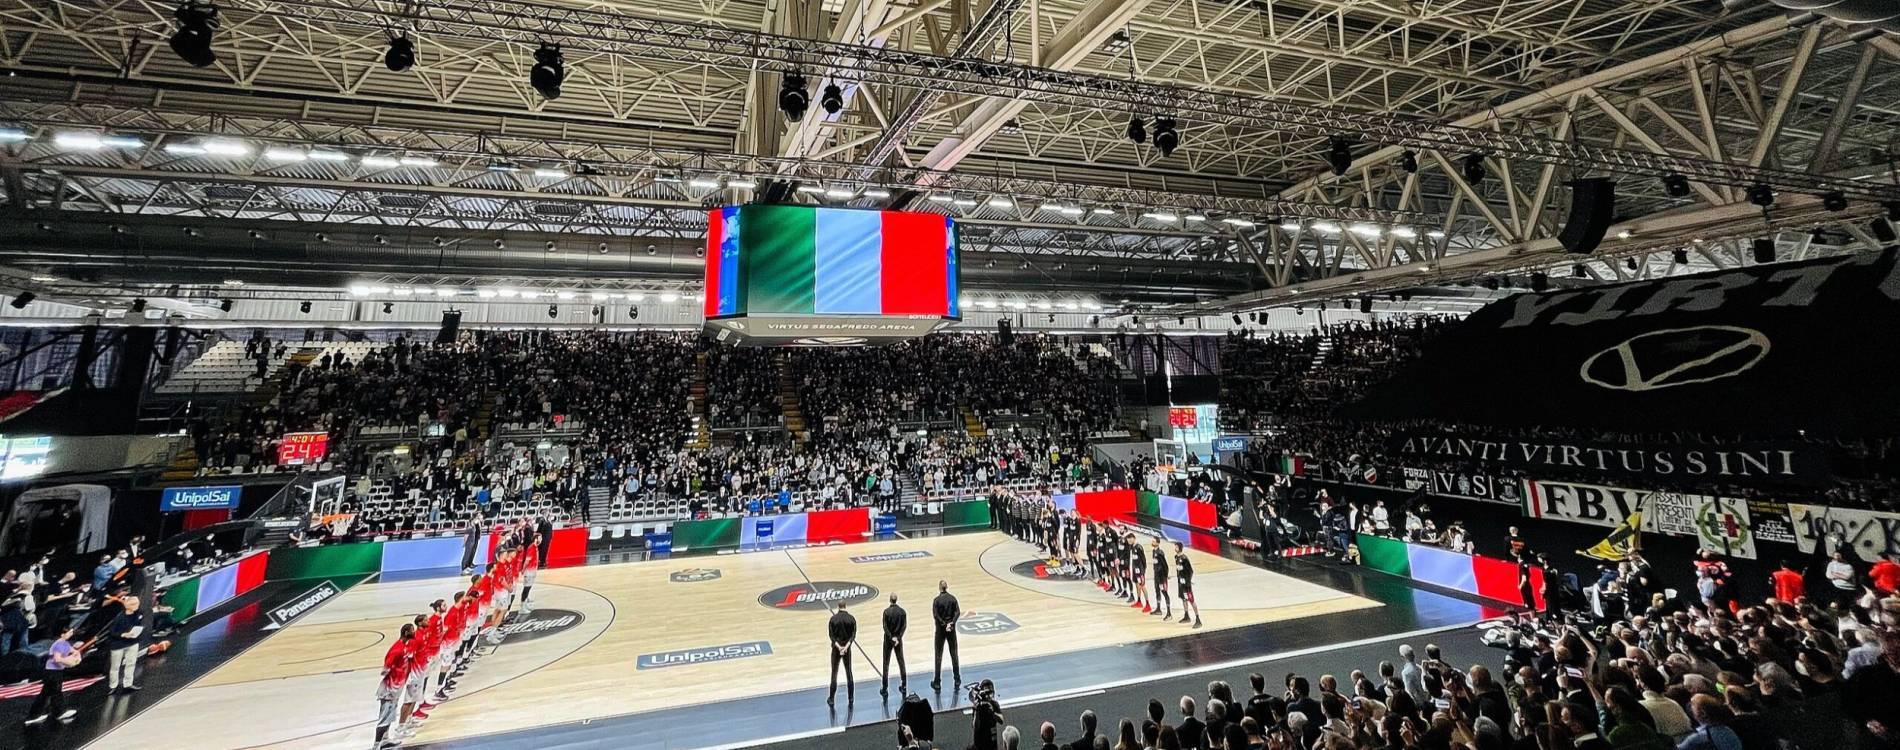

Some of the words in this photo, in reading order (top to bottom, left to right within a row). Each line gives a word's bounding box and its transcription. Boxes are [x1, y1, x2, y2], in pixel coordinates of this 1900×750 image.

[282, 443, 310, 459] 24
[1401, 437, 1508, 461] AVANTI
[1518, 442, 1797, 475] VIRTUSSINI
[1403, 468, 1429, 479] FORZA
[1438, 472, 1455, 492] V
[1472, 475, 1487, 495] S
[171, 490, 231, 507] UnipolSai
[1655, 492, 1692, 506] ASSENTI
[1655, 503, 1696, 519] PRESENTI
[857, 551, 926, 562] UnipolSai
[275, 587, 334, 621] Panasonic
[775, 586, 868, 608] Segafredo
[960, 620, 1012, 630] LBA
[650, 644, 761, 664] UnipolSai
